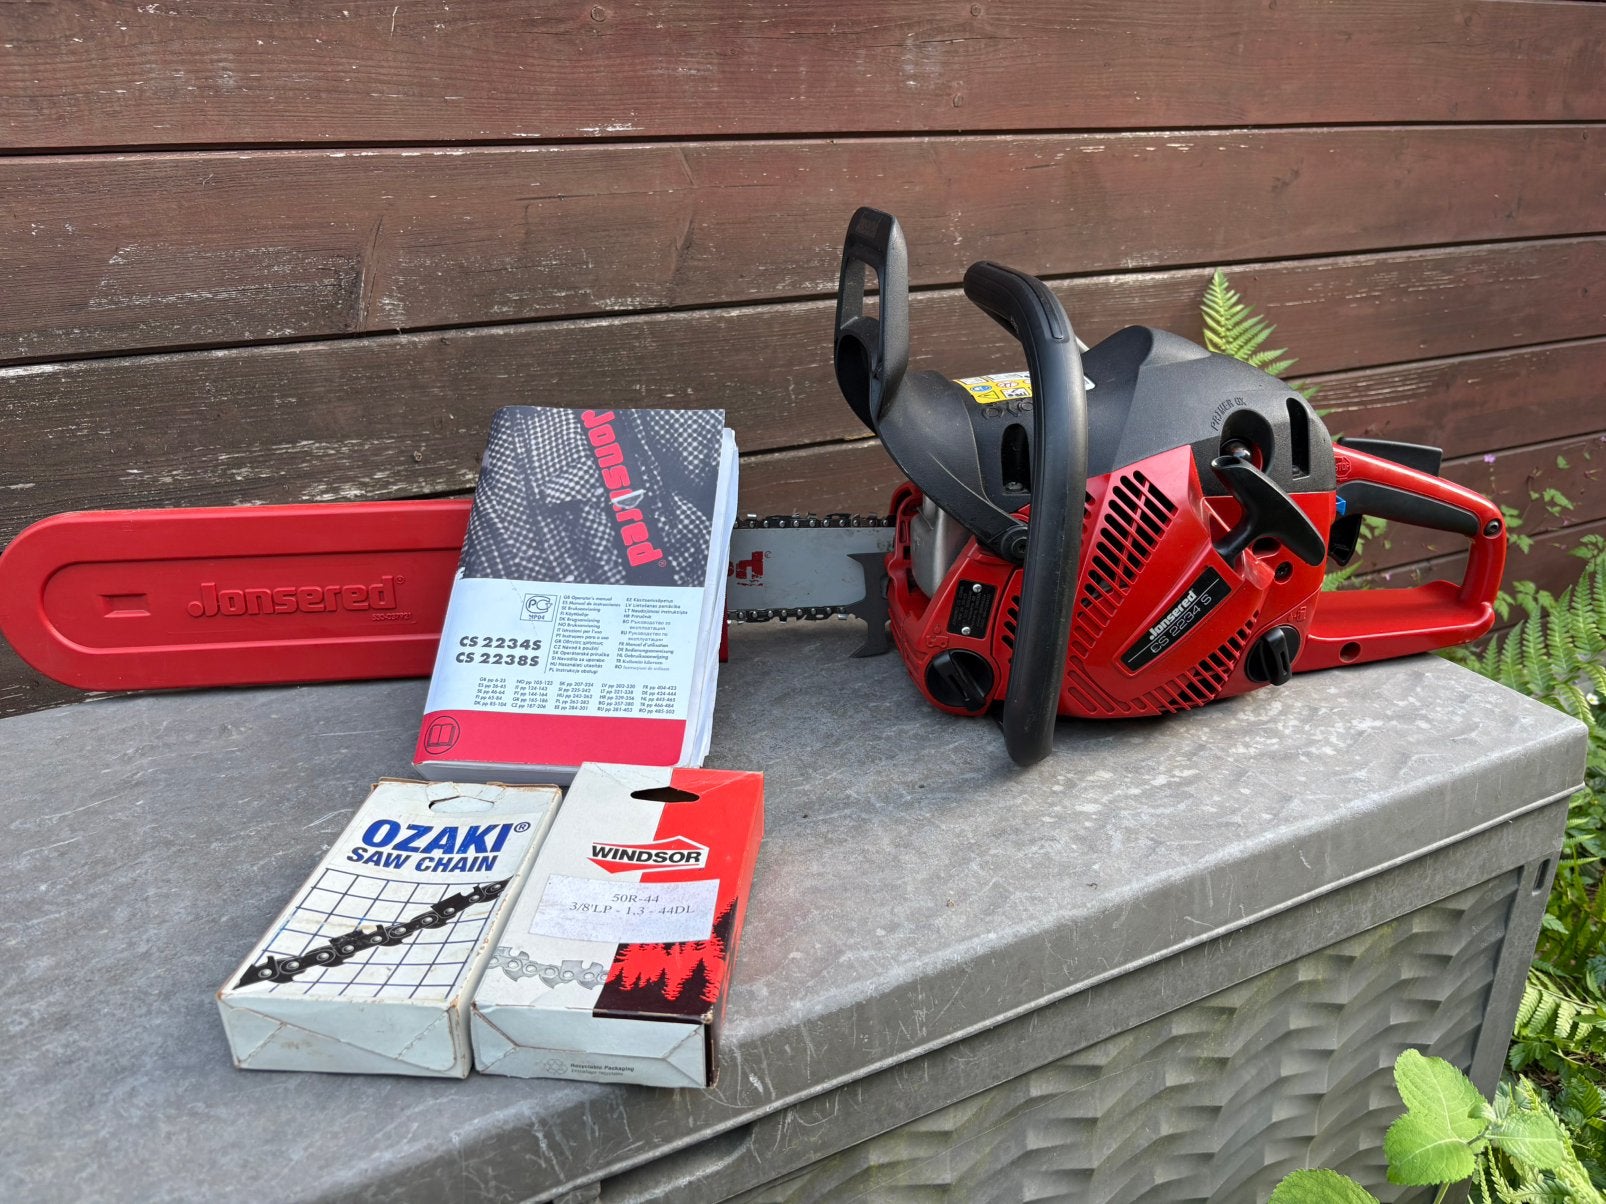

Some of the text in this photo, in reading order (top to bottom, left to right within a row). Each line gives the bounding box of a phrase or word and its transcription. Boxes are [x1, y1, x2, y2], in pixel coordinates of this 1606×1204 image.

[187, 576, 398, 617] Jonsered
[1149, 590, 1197, 640] Jonsered
[1150, 594, 1212, 653] CS 2234 S
[459, 636, 542, 650] CS 2234S
[456, 652, 540, 666] CS 2238S
[346, 846, 498, 872] SAW CHAIN
[592, 845, 702, 864] WINDSOR
[612, 894, 660, 903] 50R-44
[658, 905, 694, 914] 44DL
